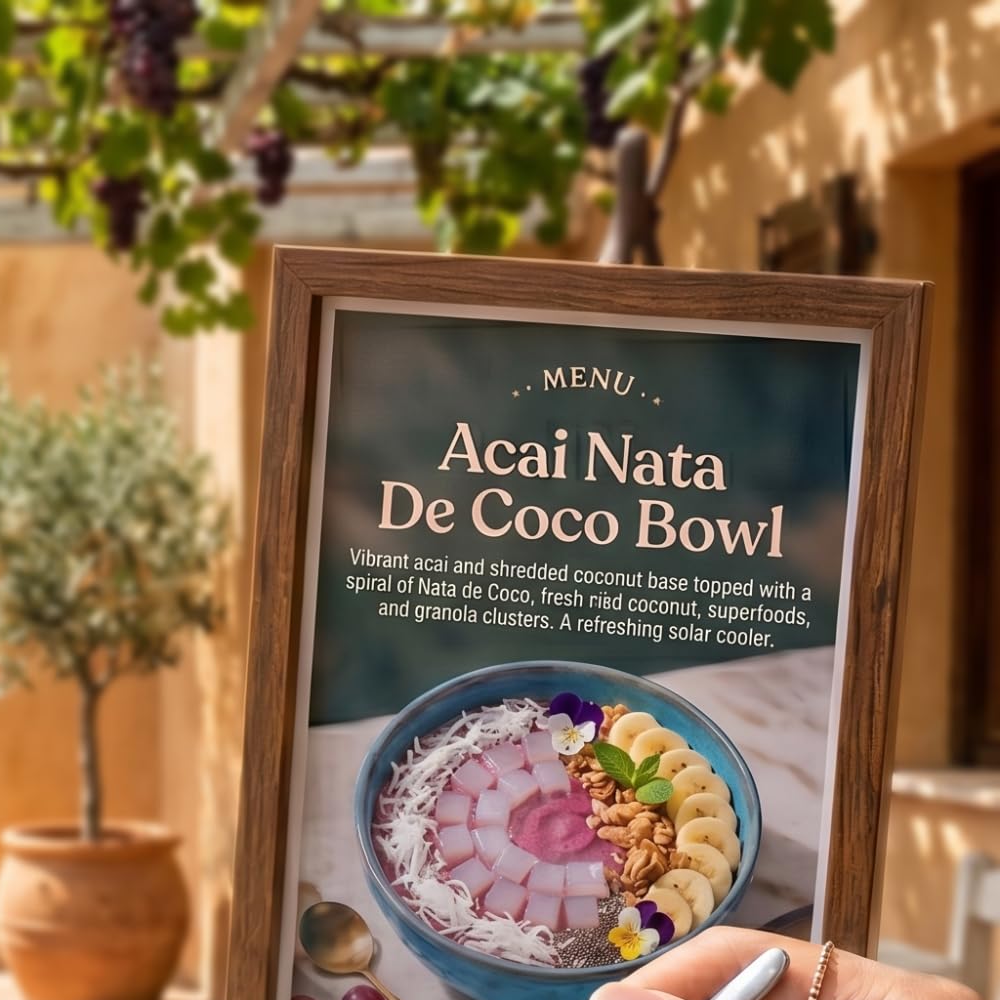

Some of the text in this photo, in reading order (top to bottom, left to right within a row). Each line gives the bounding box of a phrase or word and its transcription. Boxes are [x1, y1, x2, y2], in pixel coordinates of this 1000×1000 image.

[543, 366, 636, 396] MENU
[437, 422, 727, 491] Acai Nata
[377, 480, 784, 558] De Coco Bowl
[345, 572, 392, 594] spiral
[396, 575, 415, 594] of
[418, 576, 457, 598] Nata
[462, 580, 483, 600] de
[487, 582, 535, 607] Coco,
[541, 586, 584, 608] fresh
[627, 597, 701, 620] coconut,
[707, 603, 810, 629] superfoods,
[349, 547, 812, 601] Vibrant acai and shredded coconut base topped with a
[378, 599, 775, 648] and granola clusters. A refreshing solar cooler.
